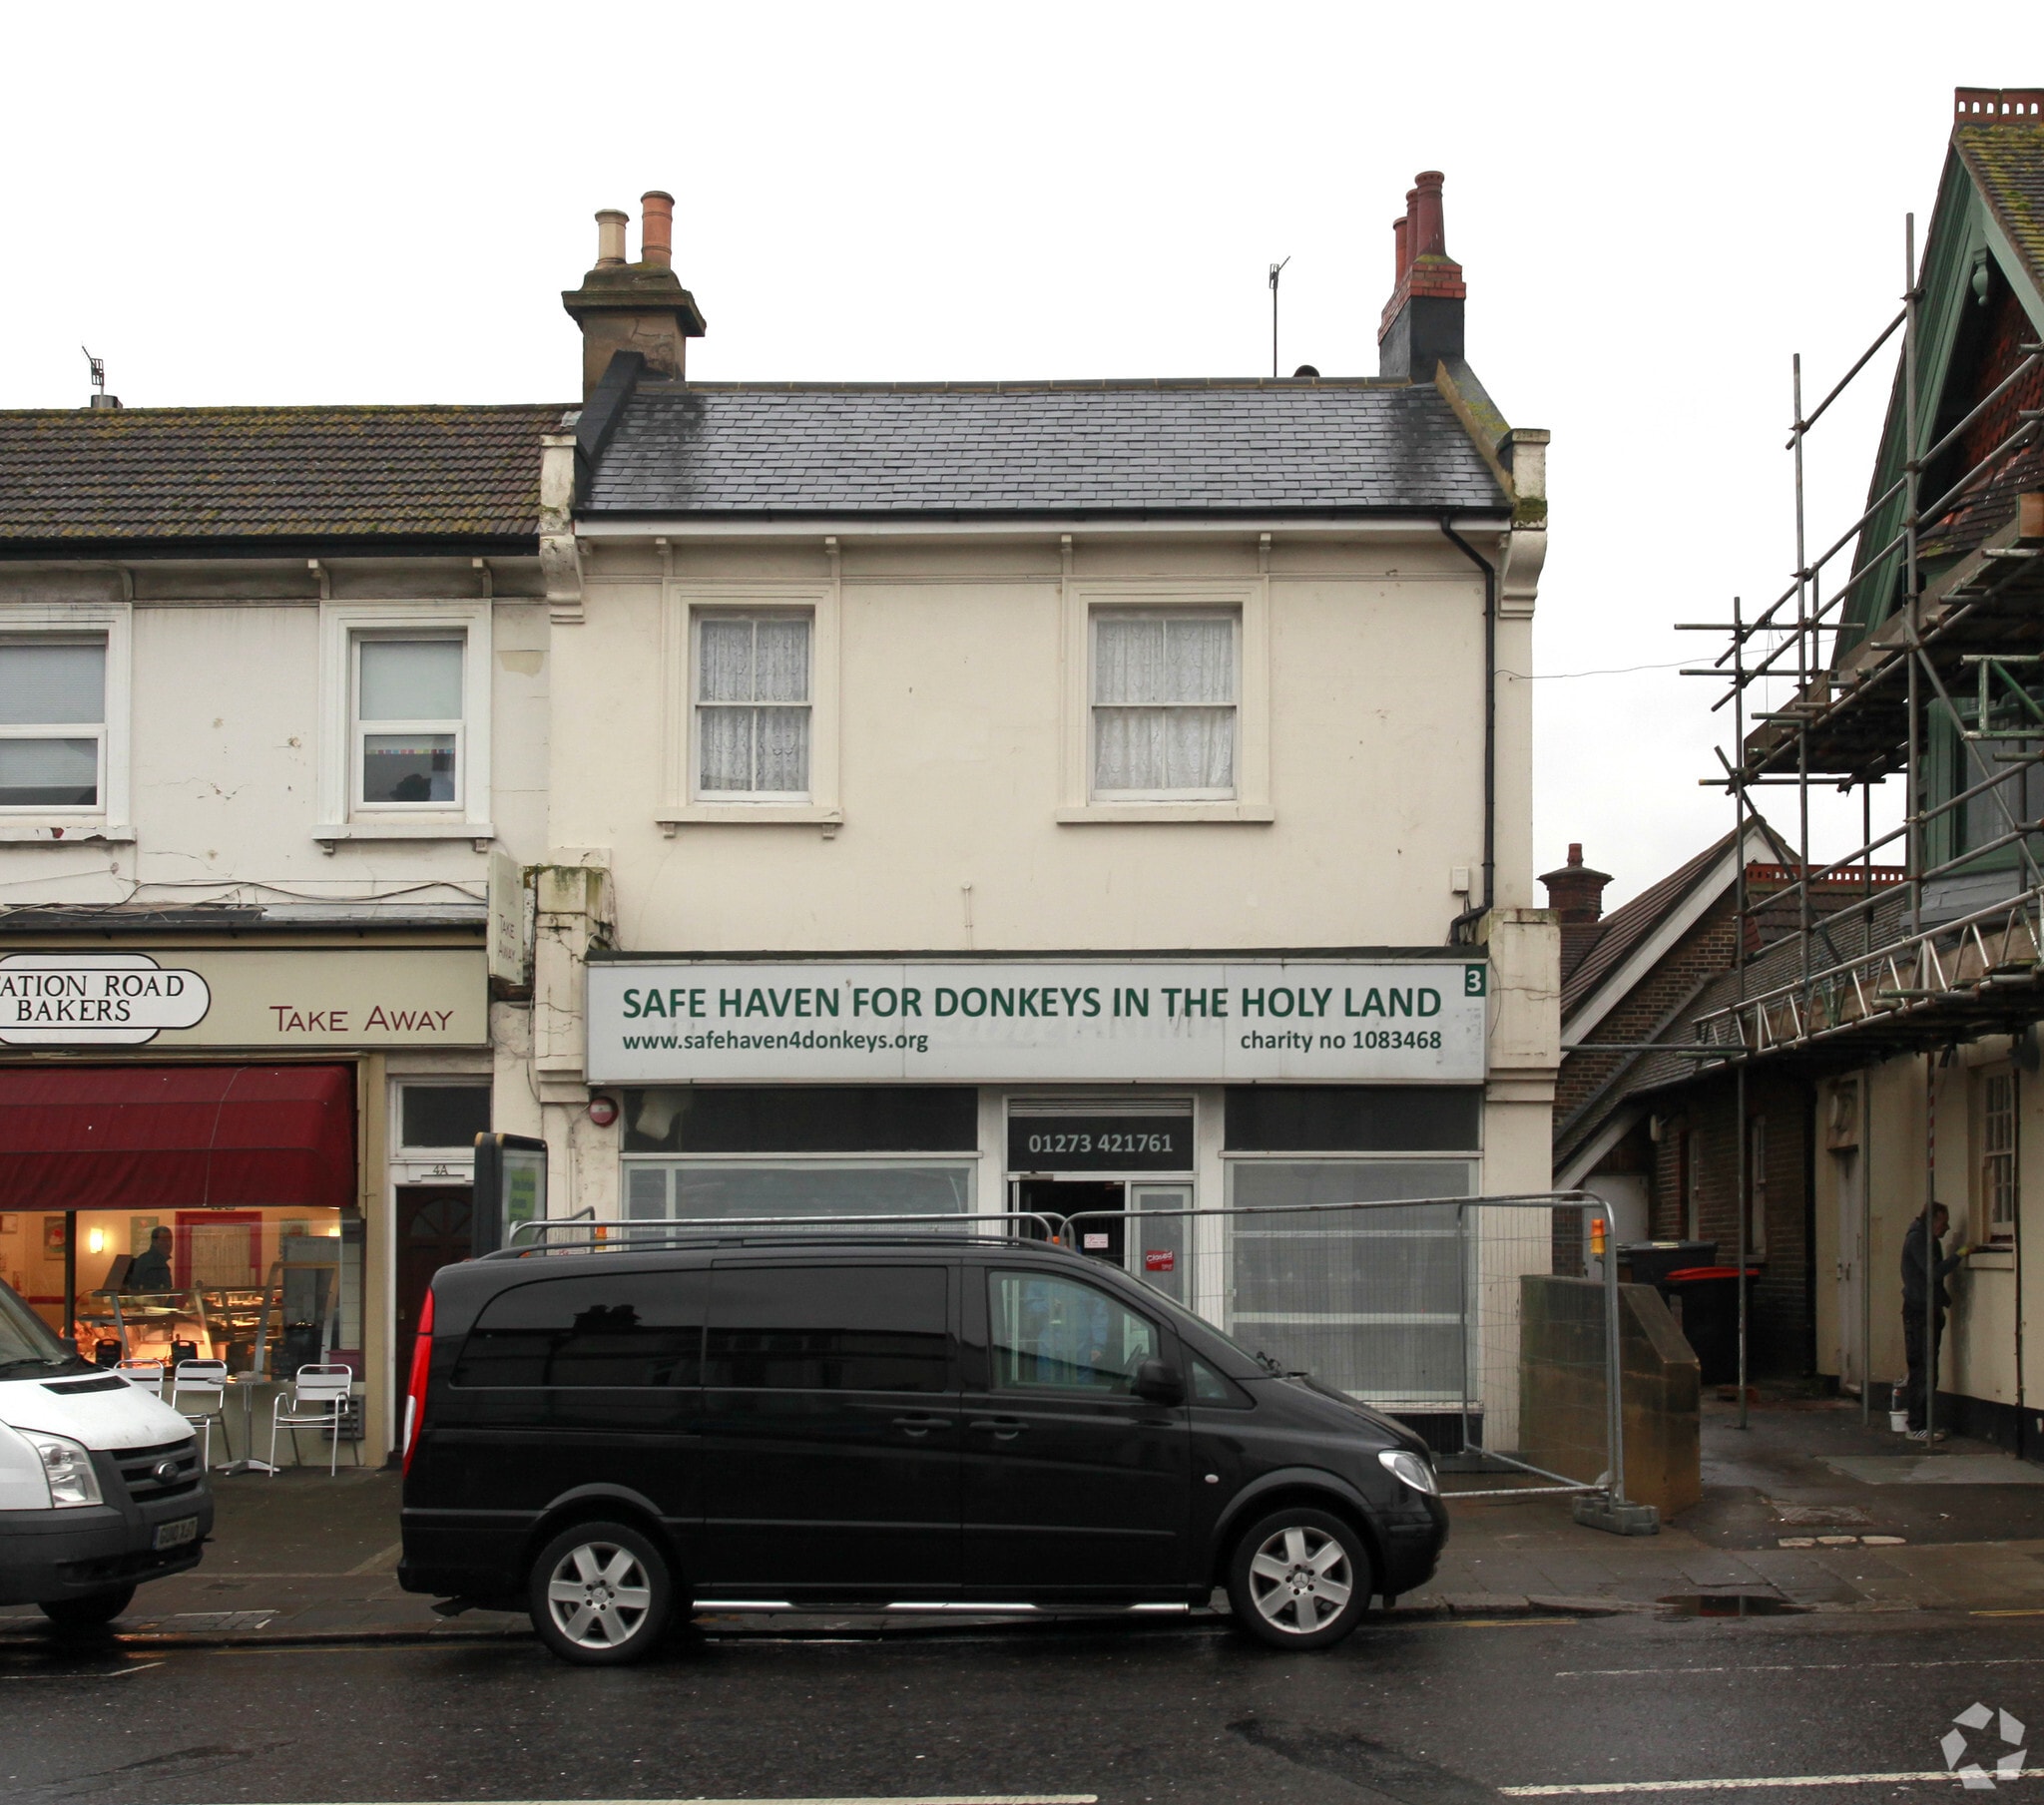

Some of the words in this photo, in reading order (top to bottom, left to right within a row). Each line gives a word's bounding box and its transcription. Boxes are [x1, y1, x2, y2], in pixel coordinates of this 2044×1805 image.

[0, 975, 88, 997] ATION
[104, 975, 185, 997] ROAD
[1467, 970, 1482, 992] 3
[16, 999, 131, 1022] BAKERS
[623, 988, 707, 1018] SAFE
[720, 988, 839, 1018] HAVEN
[853, 987, 922, 1018] FOR
[935, 987, 1101, 1018] DONKEYS
[1114, 988, 1149, 1018] IN
[1161, 988, 1229, 1018] THE
[1242, 987, 1333, 1018] HOLY
[1344, 987, 1441, 1018] LAND
[268, 1005, 349, 1032] TAKE
[363, 1005, 455, 1032] AWAY
[623, 1030, 928, 1053] www.safehaven4donkeys.org
[1241, 1030, 1313, 1053] charity
[1319, 1035, 1346, 1050] no
[1352, 1031, 1442, 1050] 1083468
[1029, 1133, 1092, 1152] 01273
[1097, 1133, 1174, 1152] 421761
[432, 1164, 449, 1175] 4A
[1146, 1250, 1174, 1262] Closed
